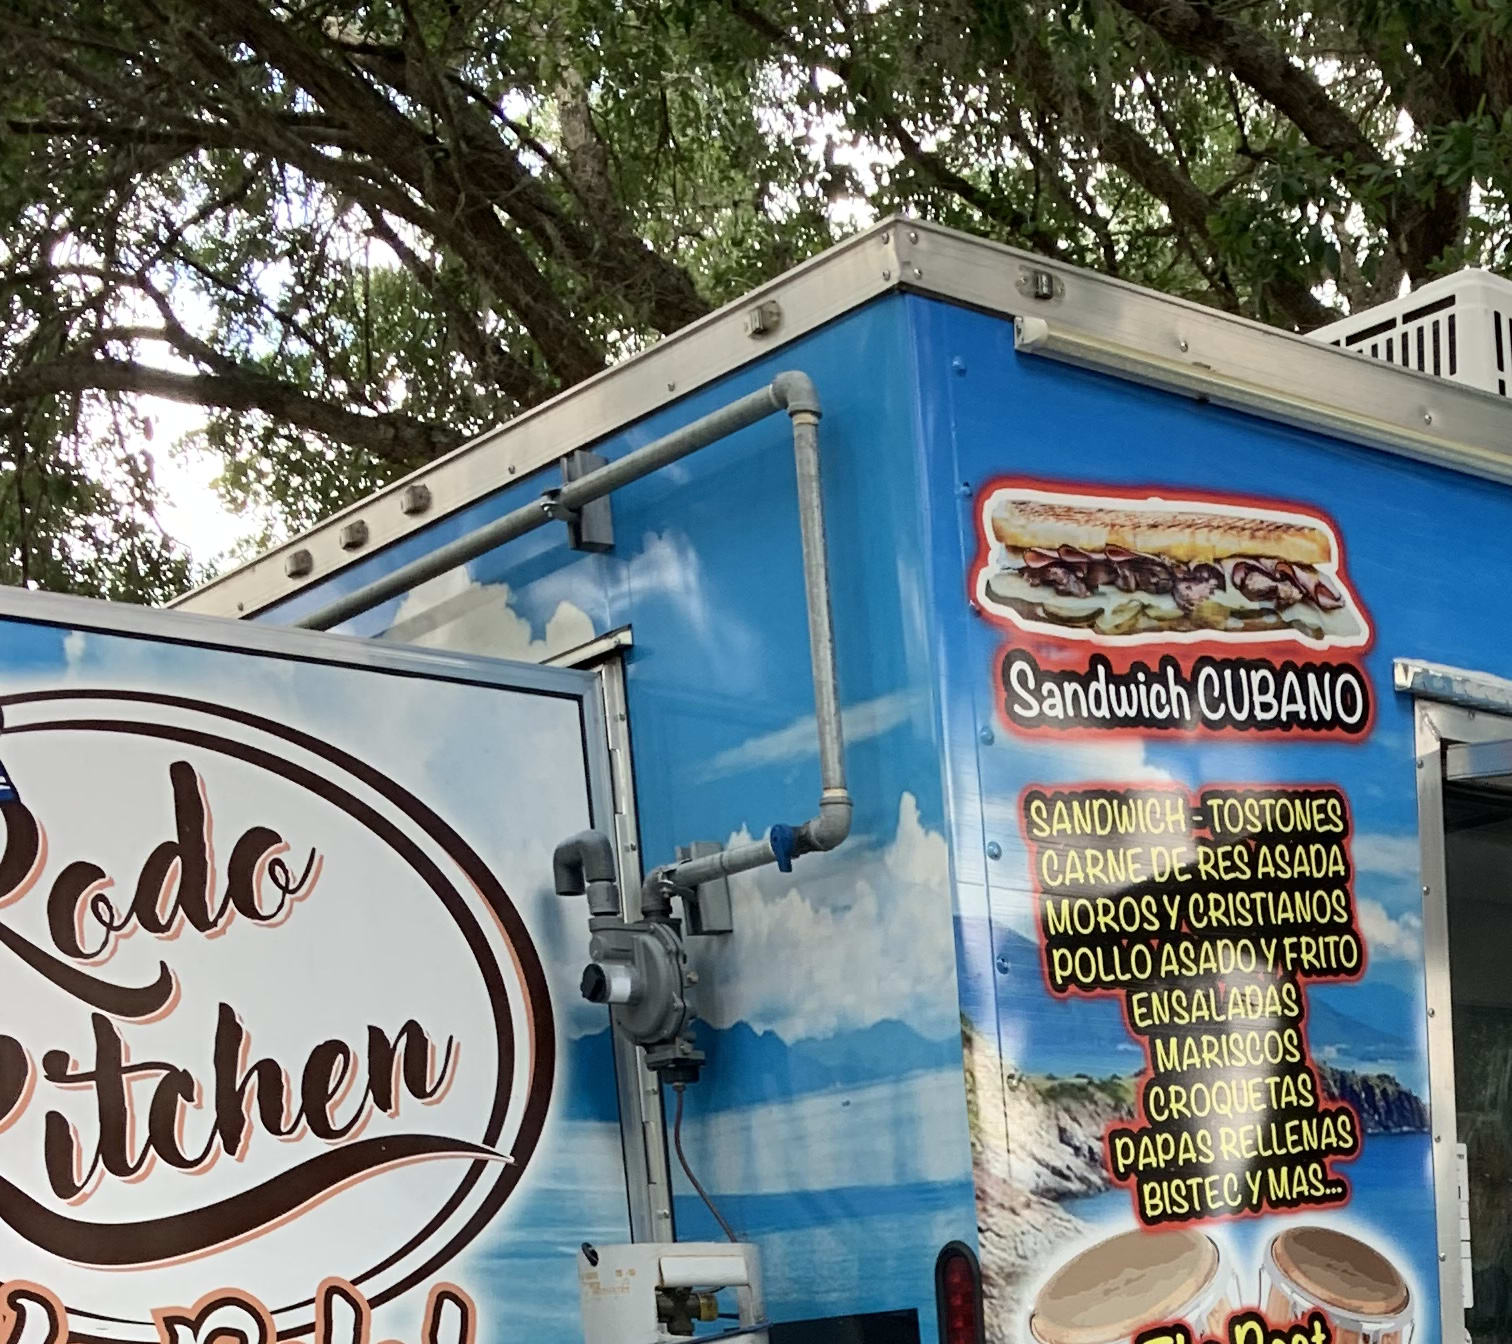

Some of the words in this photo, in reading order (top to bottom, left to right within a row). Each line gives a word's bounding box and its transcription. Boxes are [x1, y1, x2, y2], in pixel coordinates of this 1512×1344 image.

[1010, 660, 1191, 722] Sandwich
[1196, 666, 1363, 727] CUBANO
[1030, 796, 1185, 838] SANDWICH
[1207, 797, 1344, 834] TOSTONES
[1041, 846, 1147, 887] CARNE
[1152, 844, 1192, 883] DE
[1198, 843, 1252, 880] RES
[1257, 844, 1345, 879] ASADA
[1046, 895, 1160, 937] MOROS
[1162, 894, 1181, 931] Y
[1187, 890, 1349, 930] CRISTIANOS
[1052, 944, 1152, 985] POLLO
[1160, 939, 1256, 980] ASADO
[1260, 938, 1281, 973] Y
[1284, 934, 1358, 971] FRITO
[1132, 983, 1301, 1028] ENSALADAS
[1155, 1030, 1301, 1072] MARISCOS
[1148, 1073, 1315, 1121] CROQUETAS
[1114, 1131, 1217, 1173] PAPAS
[1219, 1117, 1354, 1163] RELLENAS
[1143, 1175, 1243, 1218] BISTEC
[1249, 1170, 1264, 1205] Y
[1268, 1166, 1343, 1201] MAS...
